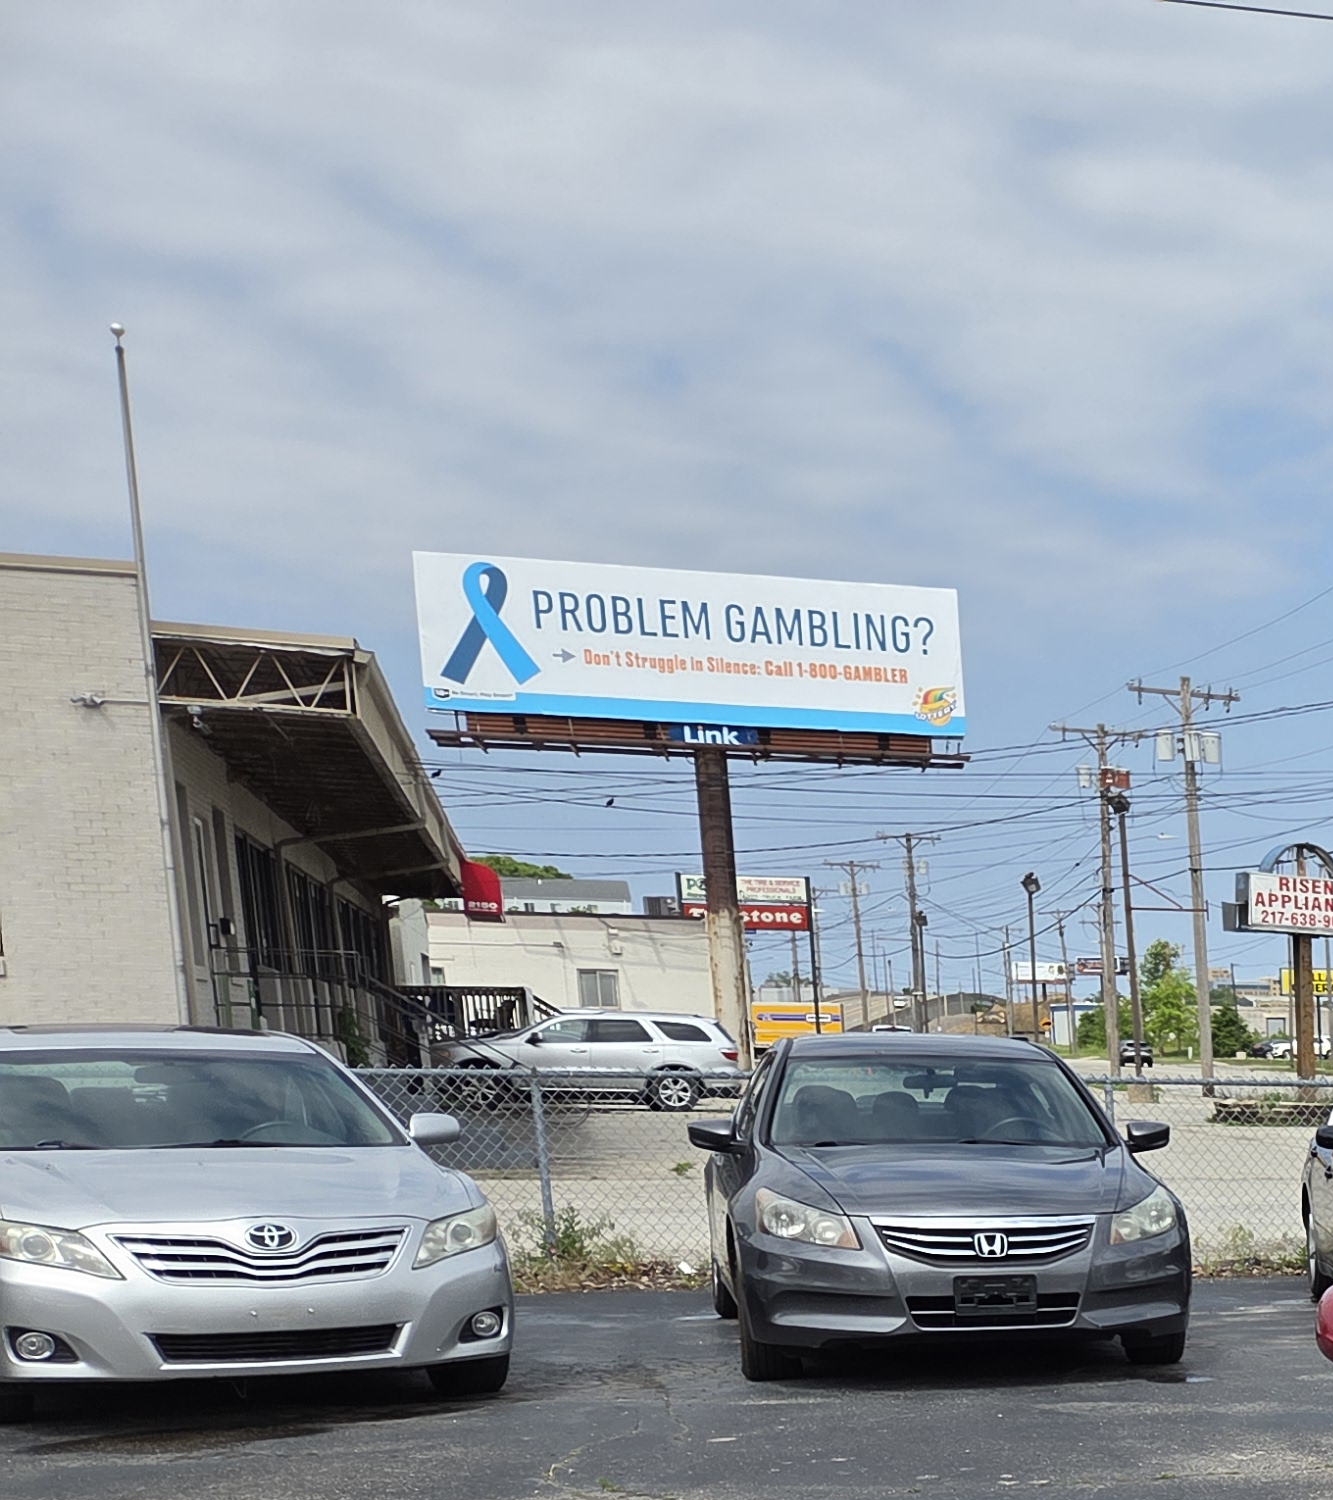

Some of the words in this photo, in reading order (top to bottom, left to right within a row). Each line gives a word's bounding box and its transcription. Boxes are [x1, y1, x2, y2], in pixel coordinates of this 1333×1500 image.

[532, 589, 711, 640] PROBLEM
[724, 603, 934, 655] GAMBLING?
[583, 648, 622, 667] Don't
[625, 651, 687, 674] Struggle
[690, 656, 703, 671] in
[706, 656, 761, 675] Silence:
[764, 660, 793, 677] Call
[796, 661, 908, 684] 1-800-GAMBLER
[683, 725, 743, 745] Link
